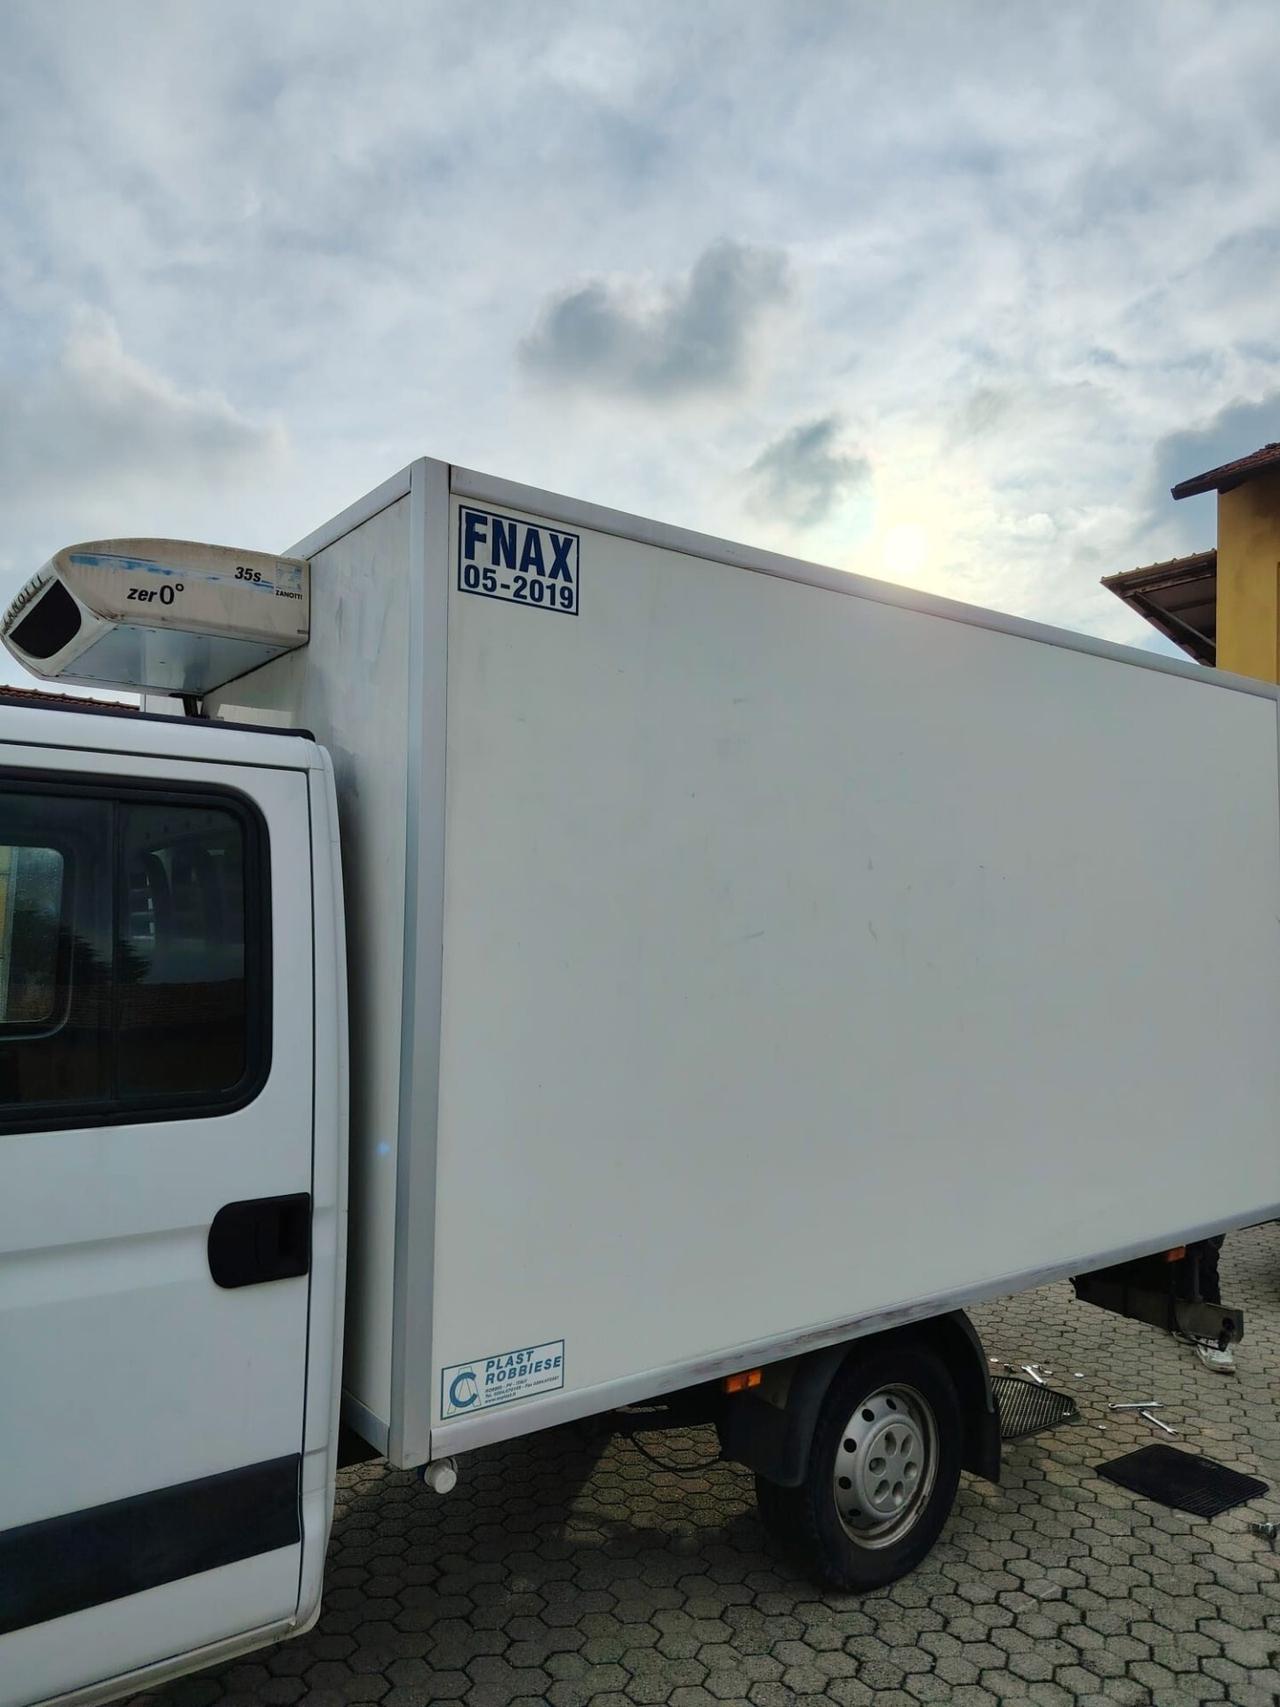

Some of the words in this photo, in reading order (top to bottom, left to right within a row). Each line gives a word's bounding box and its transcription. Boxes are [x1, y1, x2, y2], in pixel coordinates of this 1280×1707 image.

[464, 511, 574, 584] FNAX
[275, 590, 303, 601] ZANOTTI
[464, 564, 574, 610] 05-2019
[485, 1350, 535, 1373] PLAST
[485, 1356, 562, 1385] ROBBIESE
